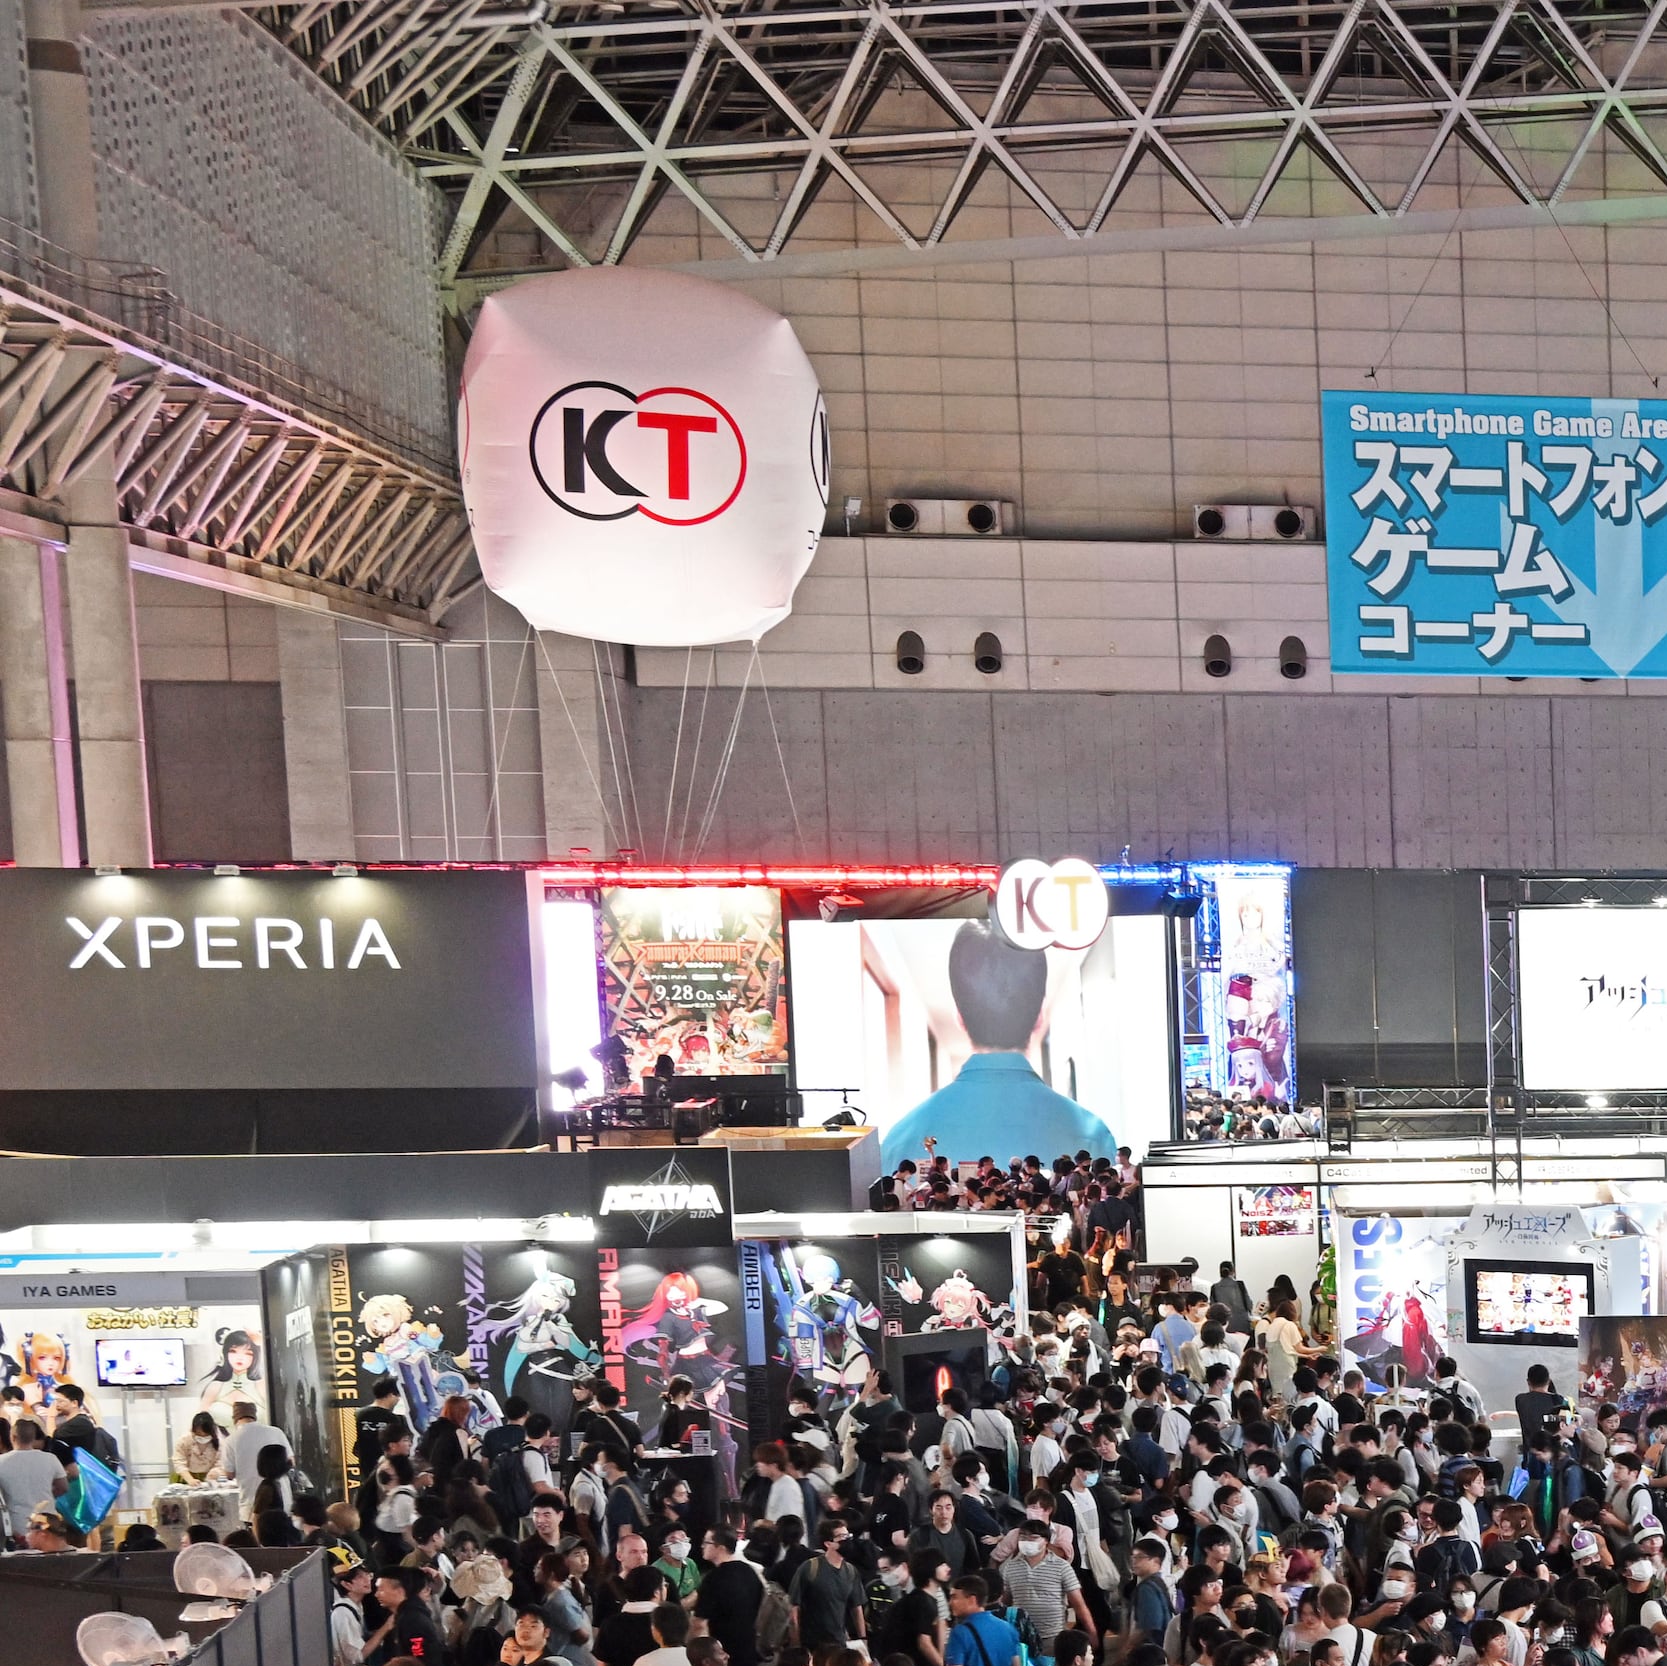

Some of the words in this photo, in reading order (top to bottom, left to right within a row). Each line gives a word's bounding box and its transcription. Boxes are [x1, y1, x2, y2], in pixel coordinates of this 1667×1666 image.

[1351, 405, 1523, 439] Smartphone
[1533, 410, 1612, 438] Game
[563, 407, 717, 499] KT
[1351, 517, 1573, 602] ゲーム
[1358, 603, 1589, 664] コーナー
[1014, 874, 1087, 934] KT
[65, 916, 402, 969] XPERIA
[655, 985, 694, 1002] 9.28
[696, 989, 713, 1001] On
[716, 989, 738, 1001] Sale
[23, 1286, 51, 1298] IYA
[56, 1285, 117, 1297] GAMES
[330, 1248, 351, 1308] AGATHA
[742, 1245, 761, 1310] AMBER
[333, 1316, 359, 1401] COOKIE
